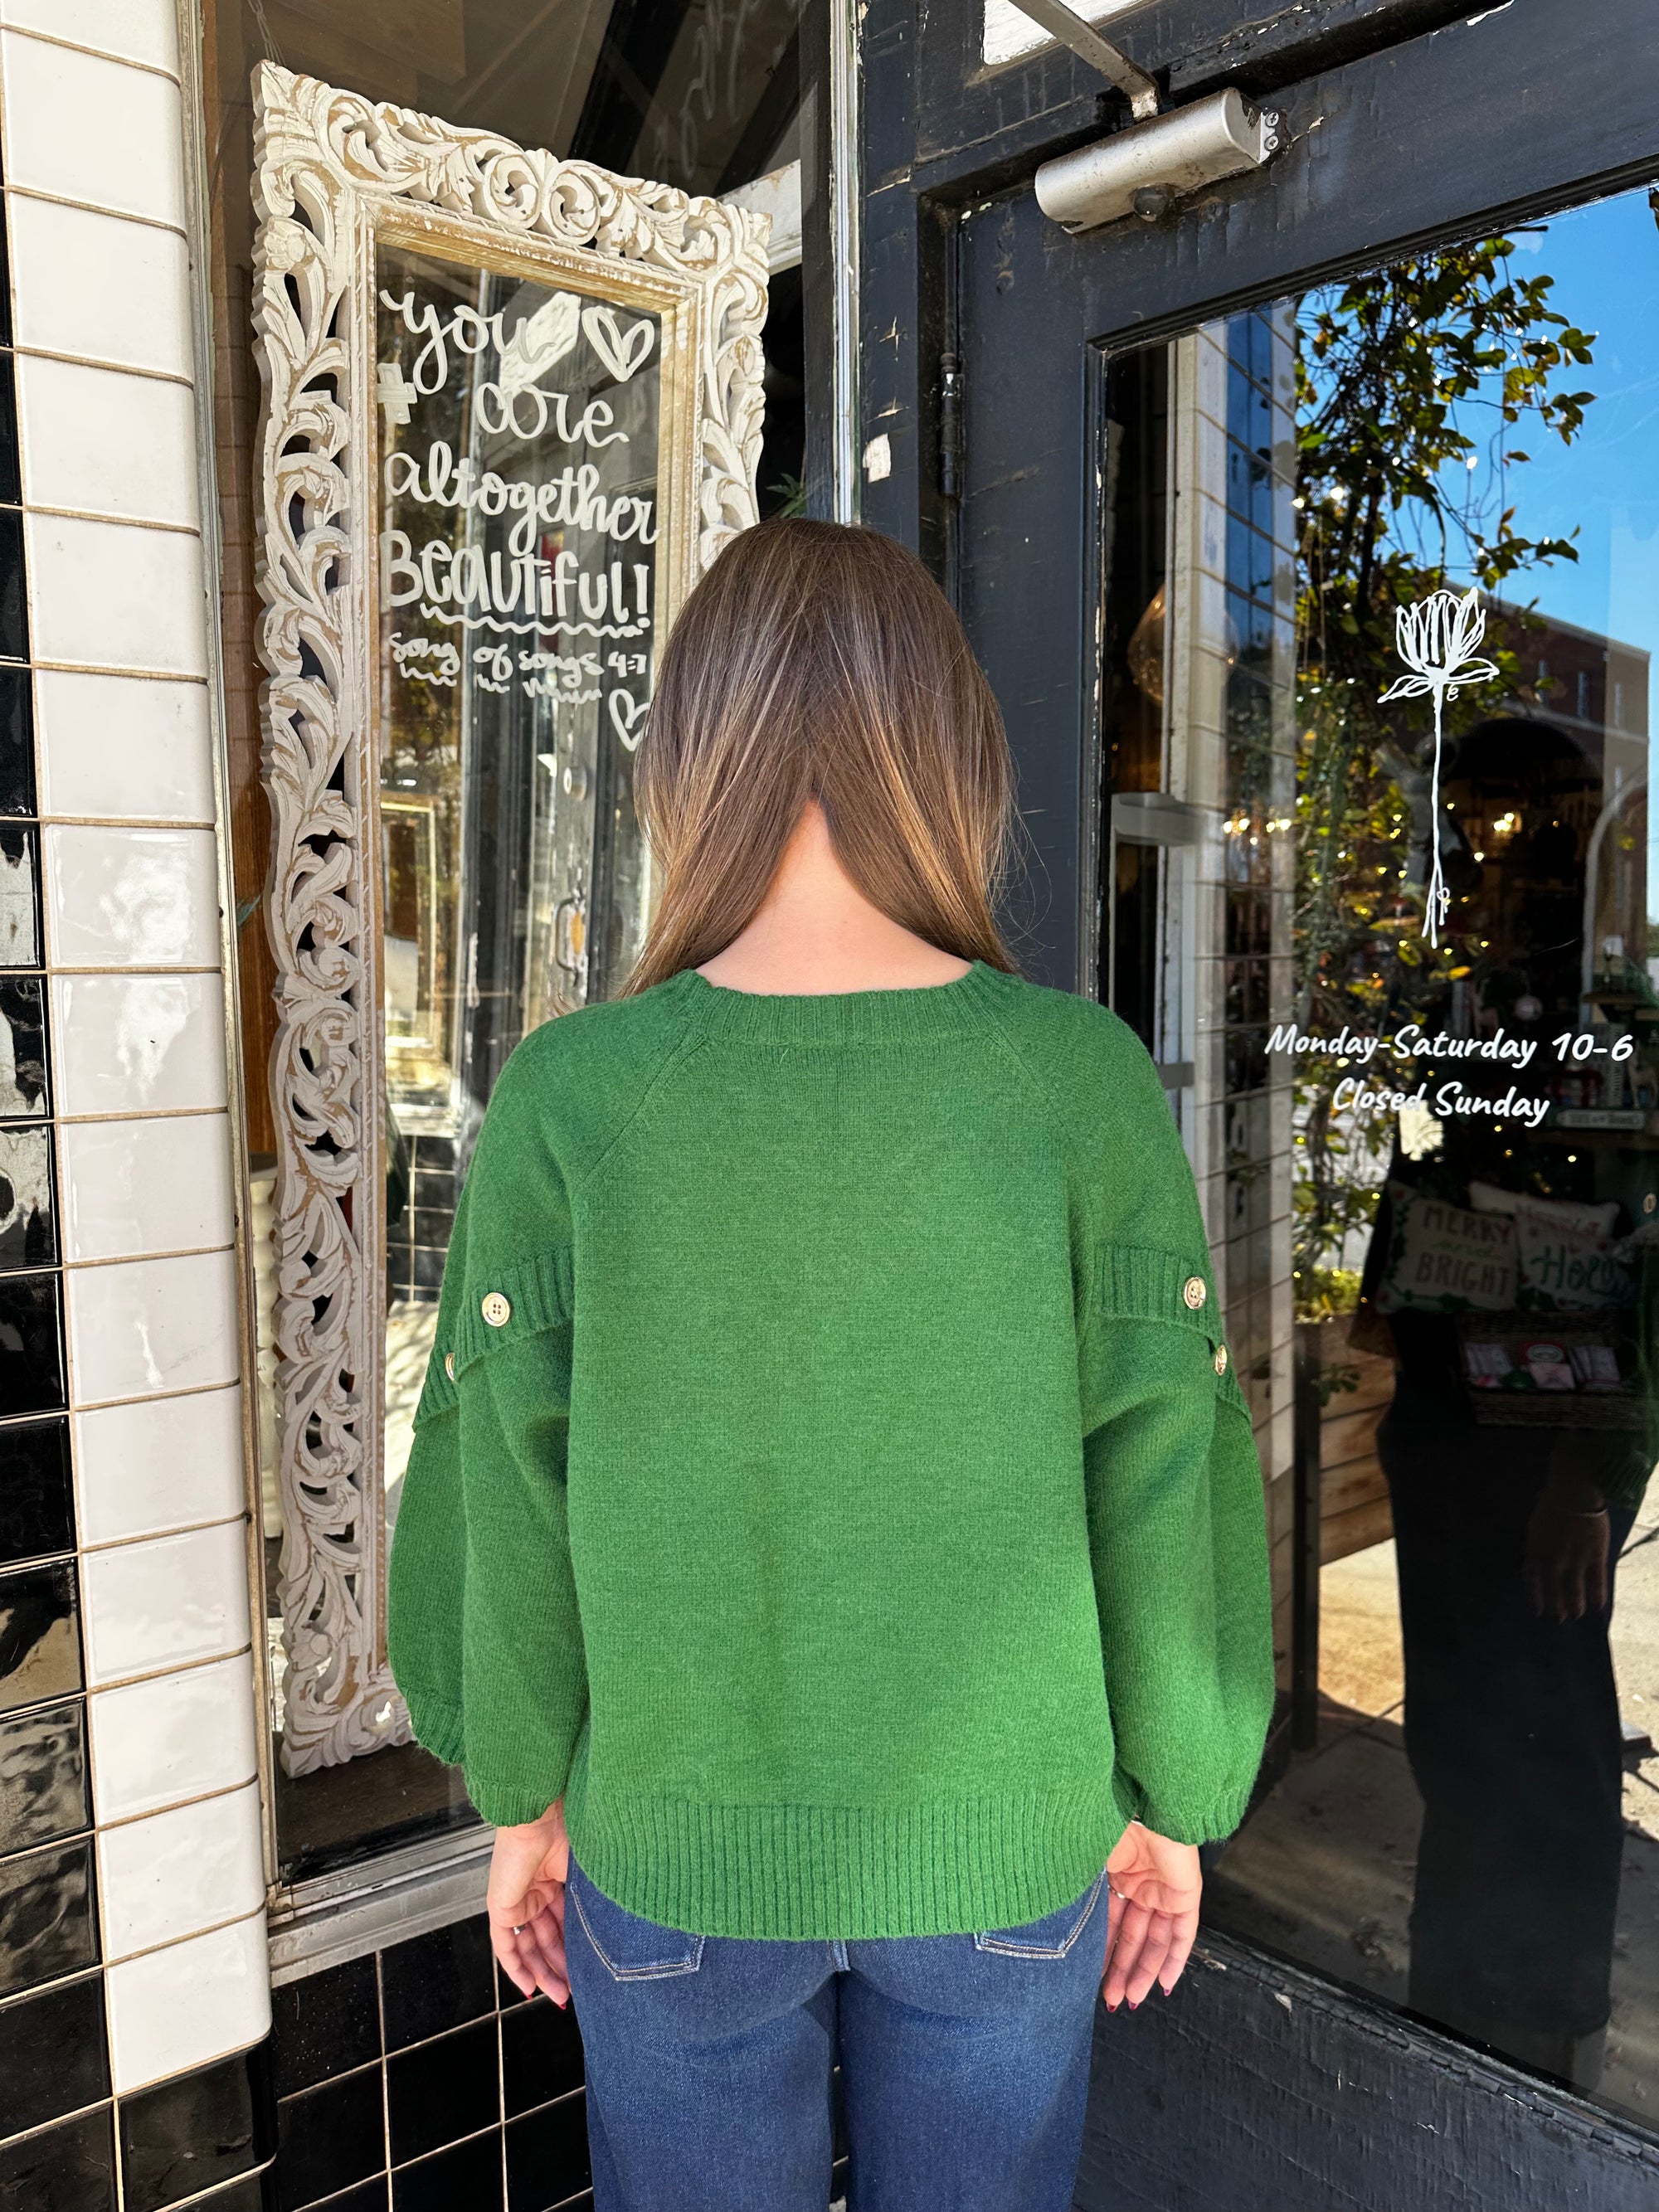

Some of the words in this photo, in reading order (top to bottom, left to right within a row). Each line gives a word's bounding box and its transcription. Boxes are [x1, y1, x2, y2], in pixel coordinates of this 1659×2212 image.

[379, 289, 557, 395] you
[384, 440, 661, 557] altogether
[473, 644, 513, 681] of
[518, 651, 605, 688] songs
[1264, 1023, 1538, 1069] Monday-Saturday
[1551, 1032, 1633, 1062] 10-6
[1332, 1077, 1426, 1112] Closed
[1434, 1081, 1550, 1128] Sunday
[1416, 1252, 1511, 1296] BRIGHT
